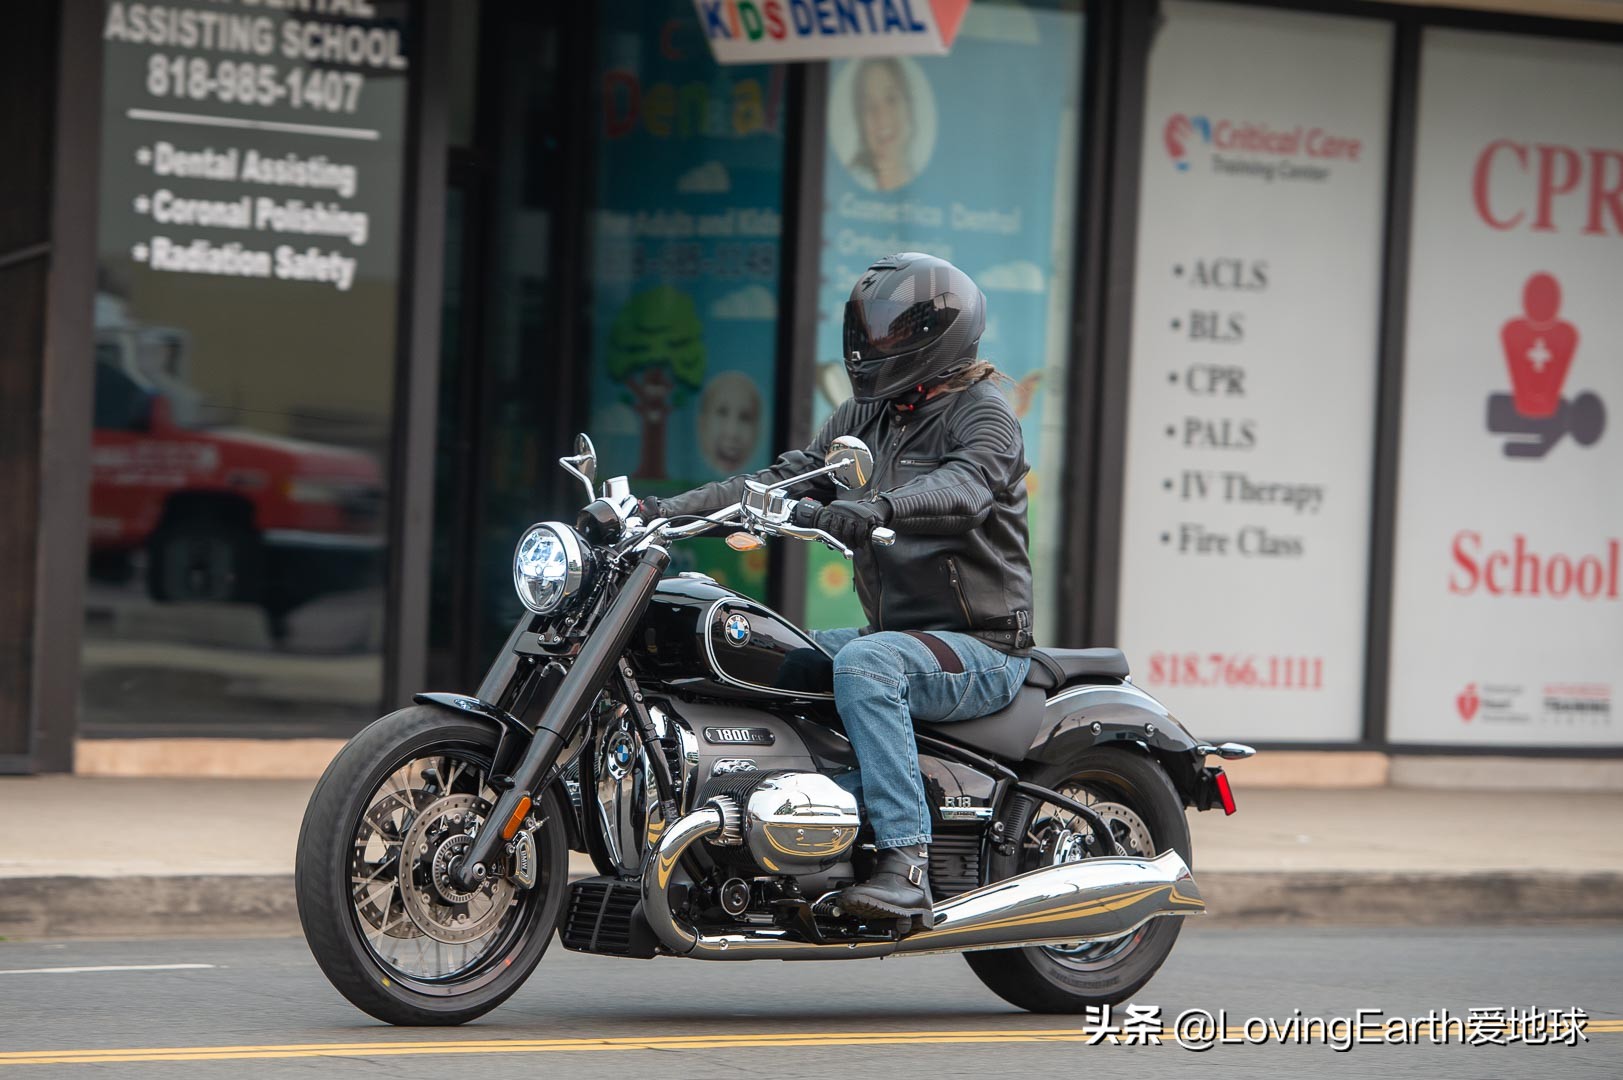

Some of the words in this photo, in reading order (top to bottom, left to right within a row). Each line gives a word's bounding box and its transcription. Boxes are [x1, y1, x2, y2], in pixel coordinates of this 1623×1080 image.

[104, 3, 274, 54] ASSISTING
[281, 20, 407, 68] SCHOOL
[704, 0, 788, 42] KIDS
[794, 0, 928, 37] DENTAL
[147, 53, 363, 112] 818-985-1407
[1213, 119, 1303, 155] Critical
[1306, 127, 1363, 161] Care
[154, 141, 238, 181] Dental
[241, 149, 356, 198] Assisting
[1212, 154, 1276, 183] Training
[1471, 137, 1623, 240] CPR
[152, 189, 251, 229] Coronal
[255, 197, 369, 245] Polishing
[150, 236, 271, 278] Radiation
[274, 245, 356, 291] Safety
[1190, 257, 1269, 291] ACLS
[1188, 310, 1245, 343] BLS
[1186, 362, 1246, 397] CPR
[1183, 416, 1257, 449] PALS
[1180, 469, 1212, 501] IV
[1220, 471, 1325, 515] Therapy
[1178, 523, 1229, 556] Fire
[1237, 524, 1304, 559] Class
[1448, 529, 1621, 602] School
[1148, 651, 1324, 690] 818.766.1111
[716, 729, 750, 741] 1800
